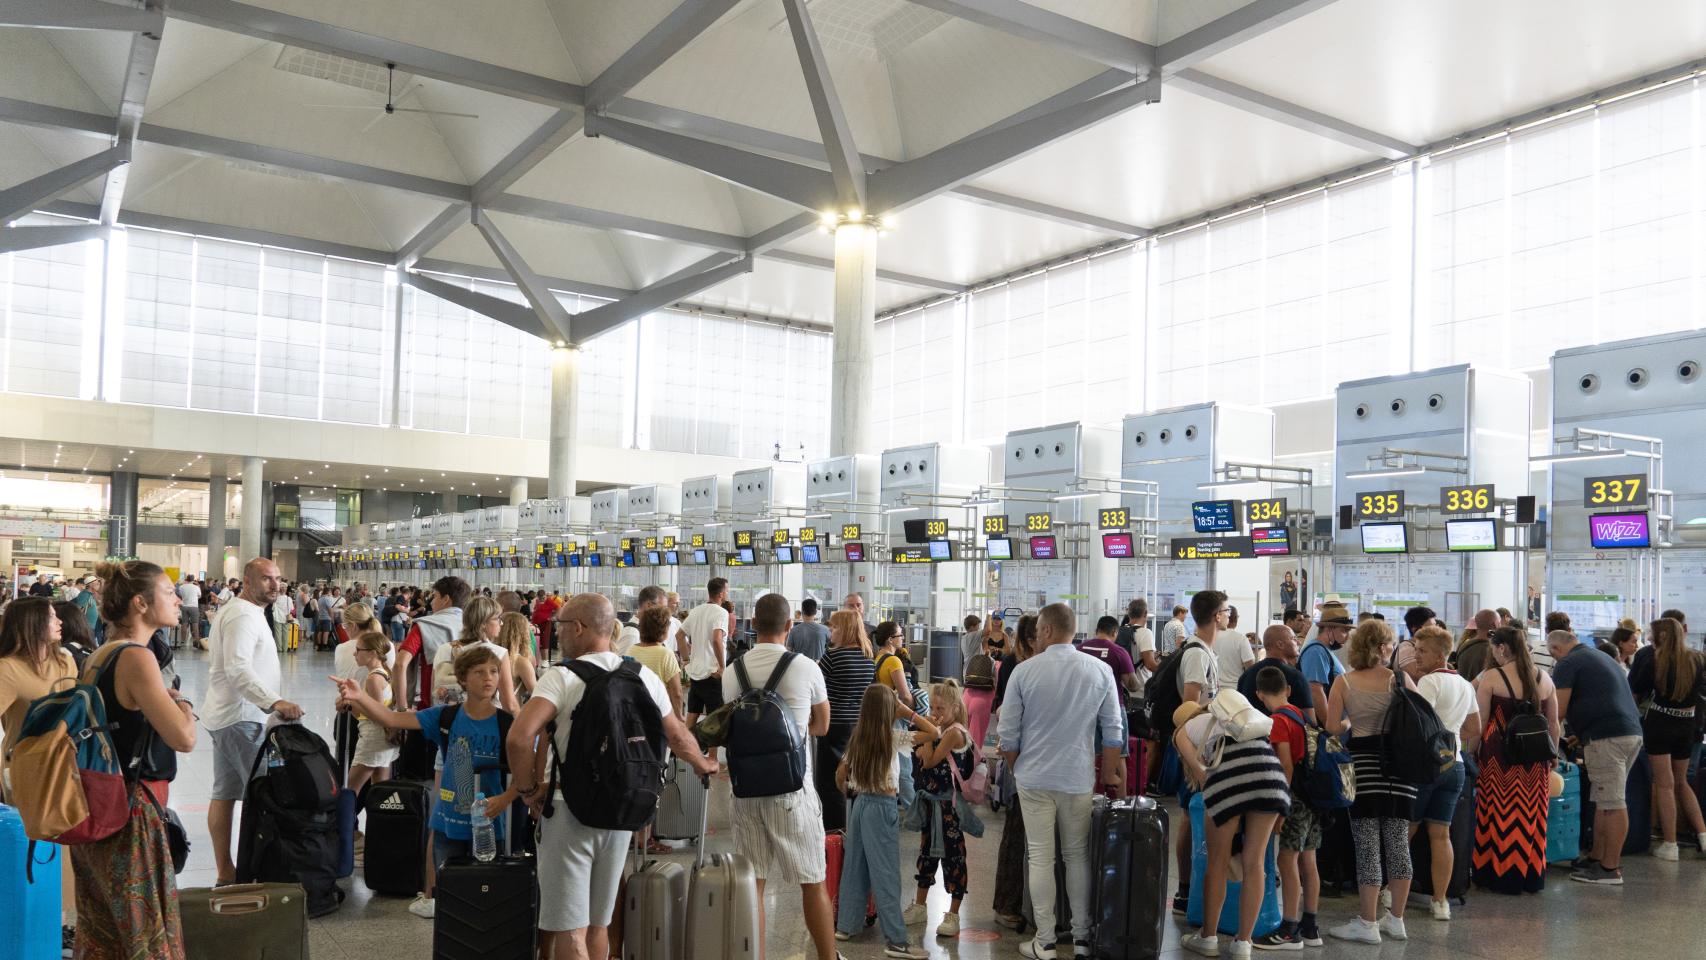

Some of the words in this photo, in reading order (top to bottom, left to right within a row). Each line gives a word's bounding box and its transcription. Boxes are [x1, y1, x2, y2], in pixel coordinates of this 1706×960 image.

[1590, 479, 1641, 503] 337
[1361, 494, 1399, 516] 335
[1446, 488, 1489, 511] 336
[1250, 502, 1282, 520] 334
[985, 518, 1004, 532] 331
[1028, 515, 1050, 530] 332
[1102, 510, 1126, 527] 333
[1198, 516, 1215, 526] 18:57
[801, 528, 814, 541] 328
[844, 526, 858, 540] 329
[928, 522, 945, 536] 330
[692, 535, 703, 546] 325
[738, 533, 750, 544] 326
[774, 530, 787, 543] 327
